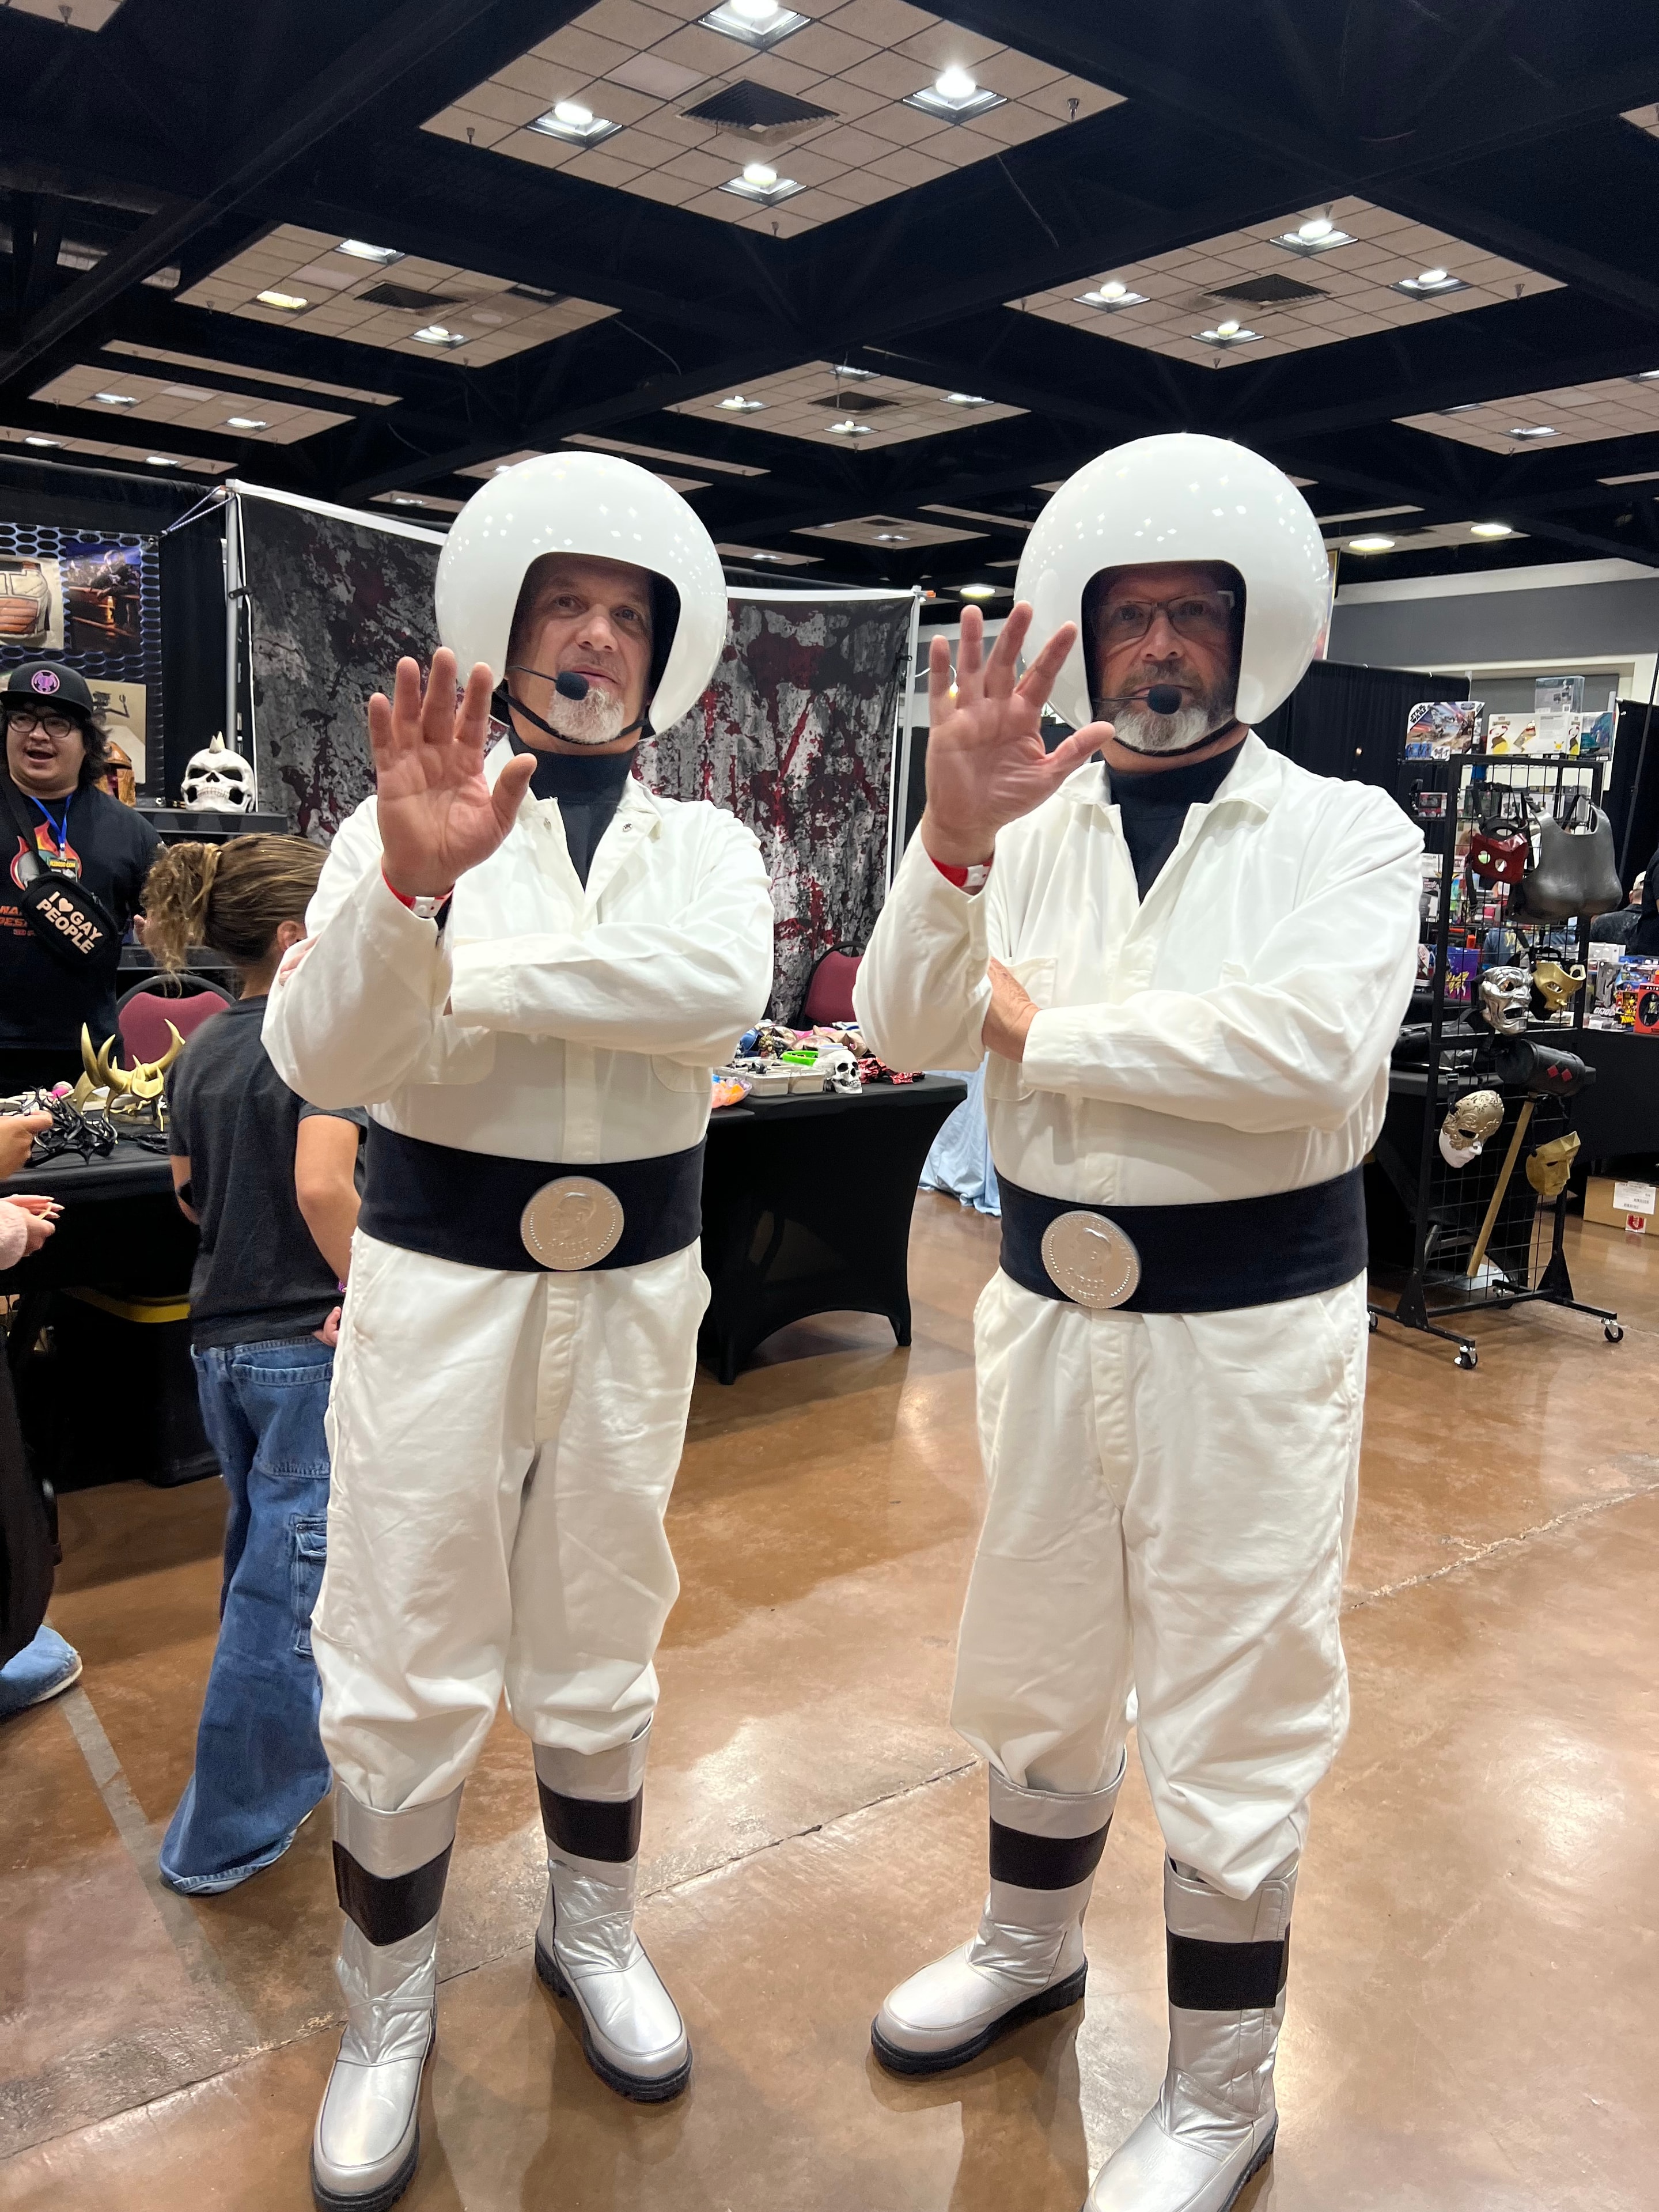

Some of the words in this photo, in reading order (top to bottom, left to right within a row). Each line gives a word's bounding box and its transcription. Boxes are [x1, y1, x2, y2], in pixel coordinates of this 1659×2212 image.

[1410, 704, 1426, 718] STAR
[1410, 708, 1427, 724] WARS
[36, 899, 95, 955] PEOPLE
[48, 891, 60, 903] I
[70, 911, 103, 941] GAY
